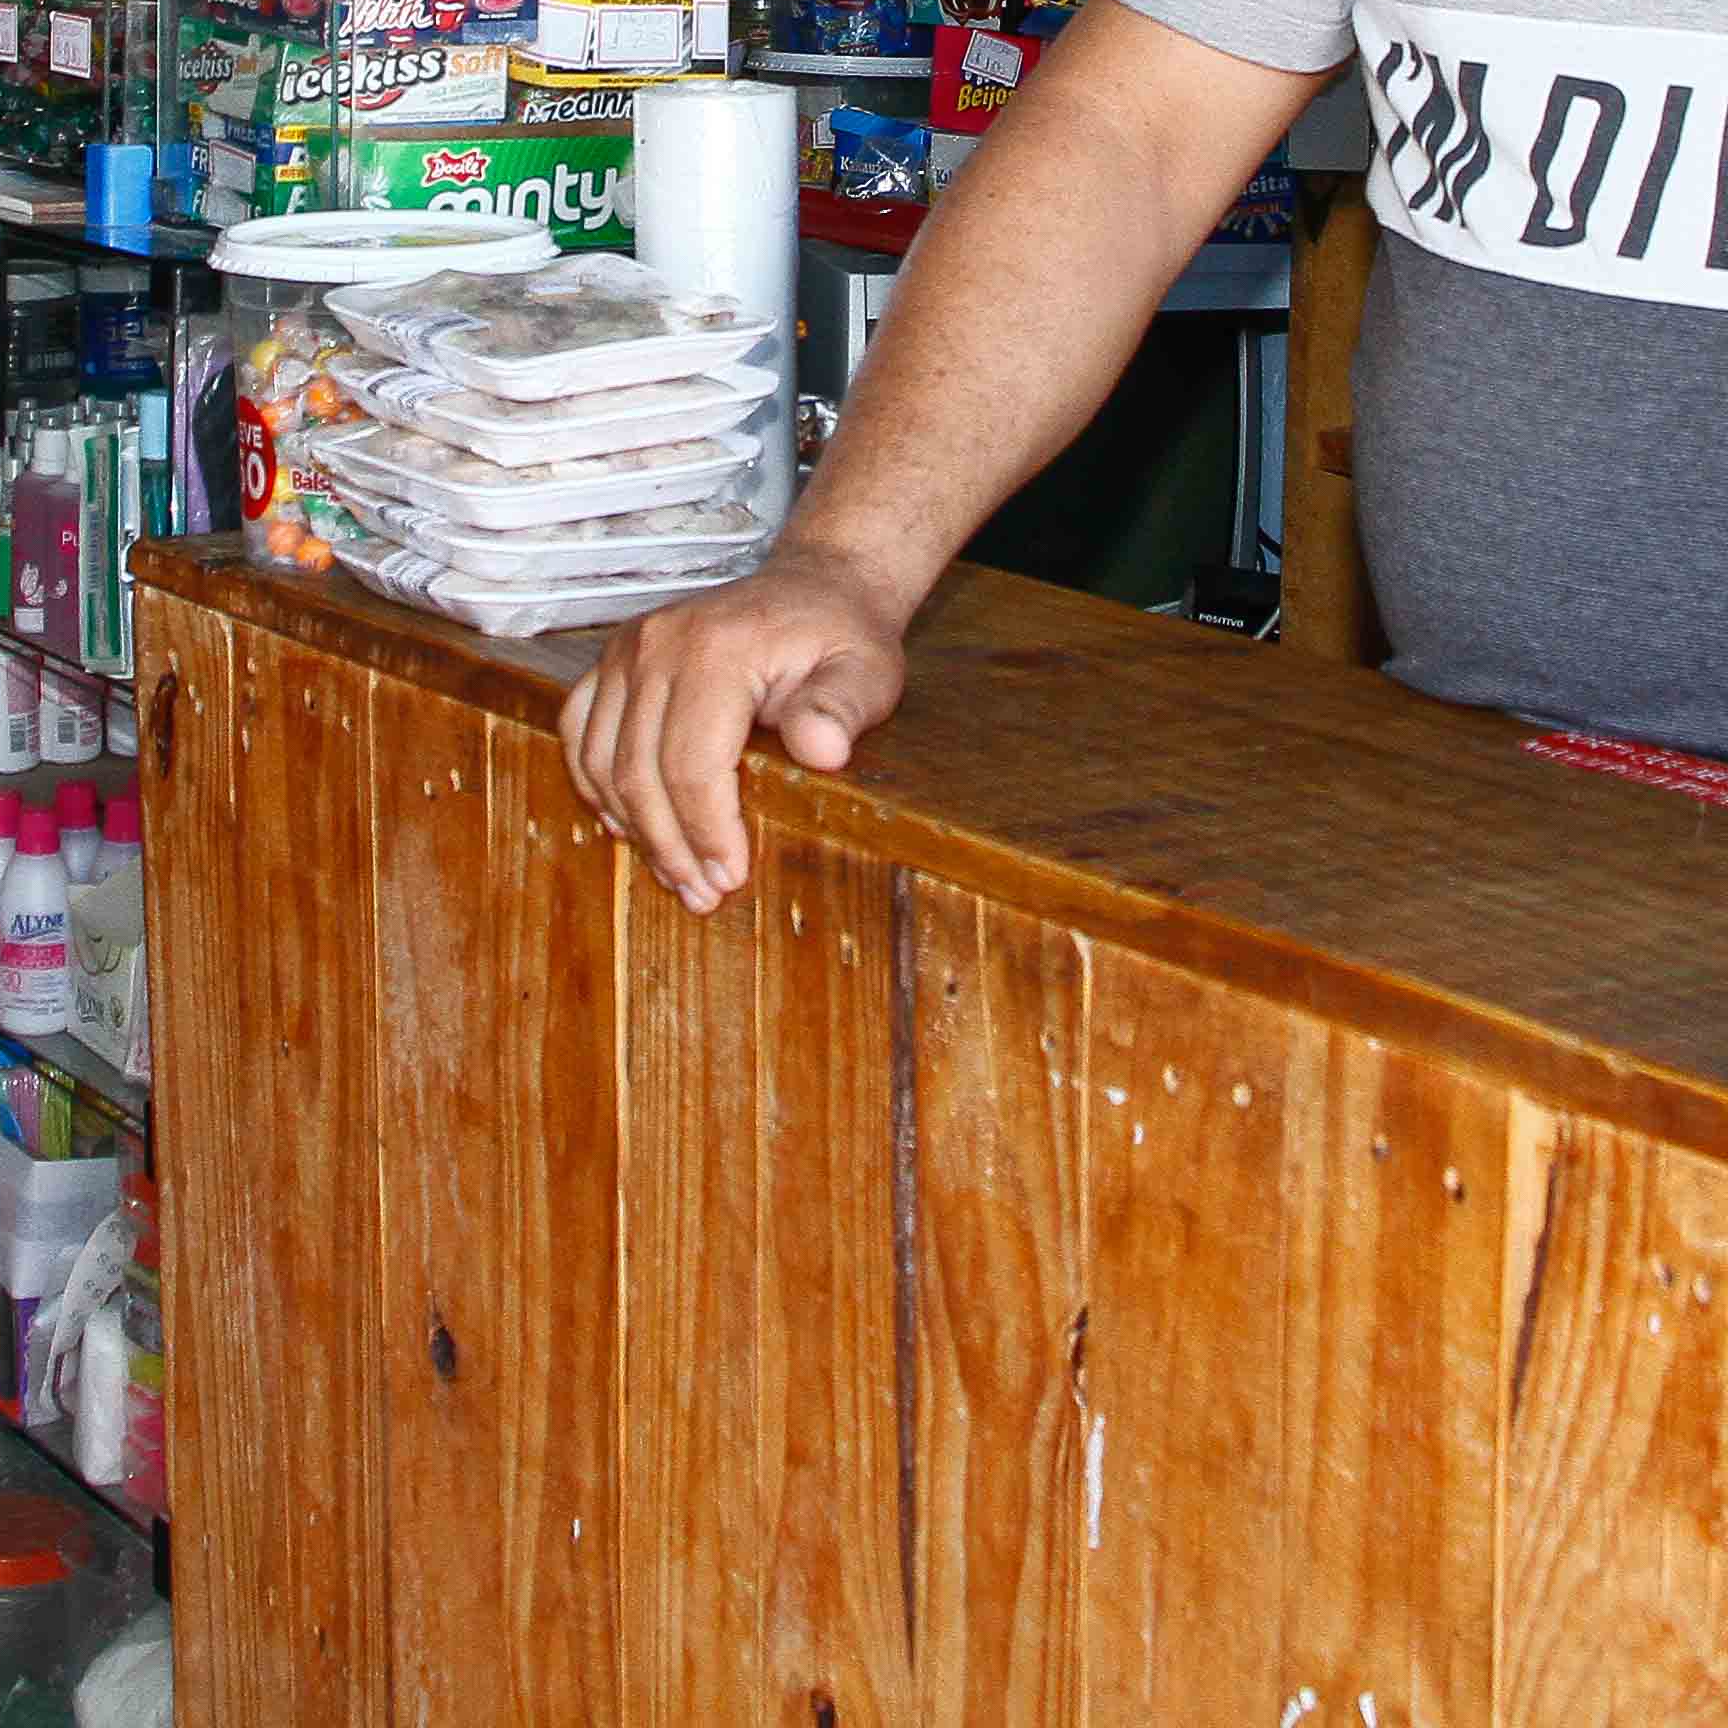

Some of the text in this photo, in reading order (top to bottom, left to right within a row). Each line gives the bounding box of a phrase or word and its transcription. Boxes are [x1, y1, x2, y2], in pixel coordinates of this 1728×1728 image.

[178, 53, 235, 82] icekiss
[281, 46, 506, 105] icekiss soft
[430, 154, 486, 181] Docile
[10, 910, 66, 939] ALYNE
